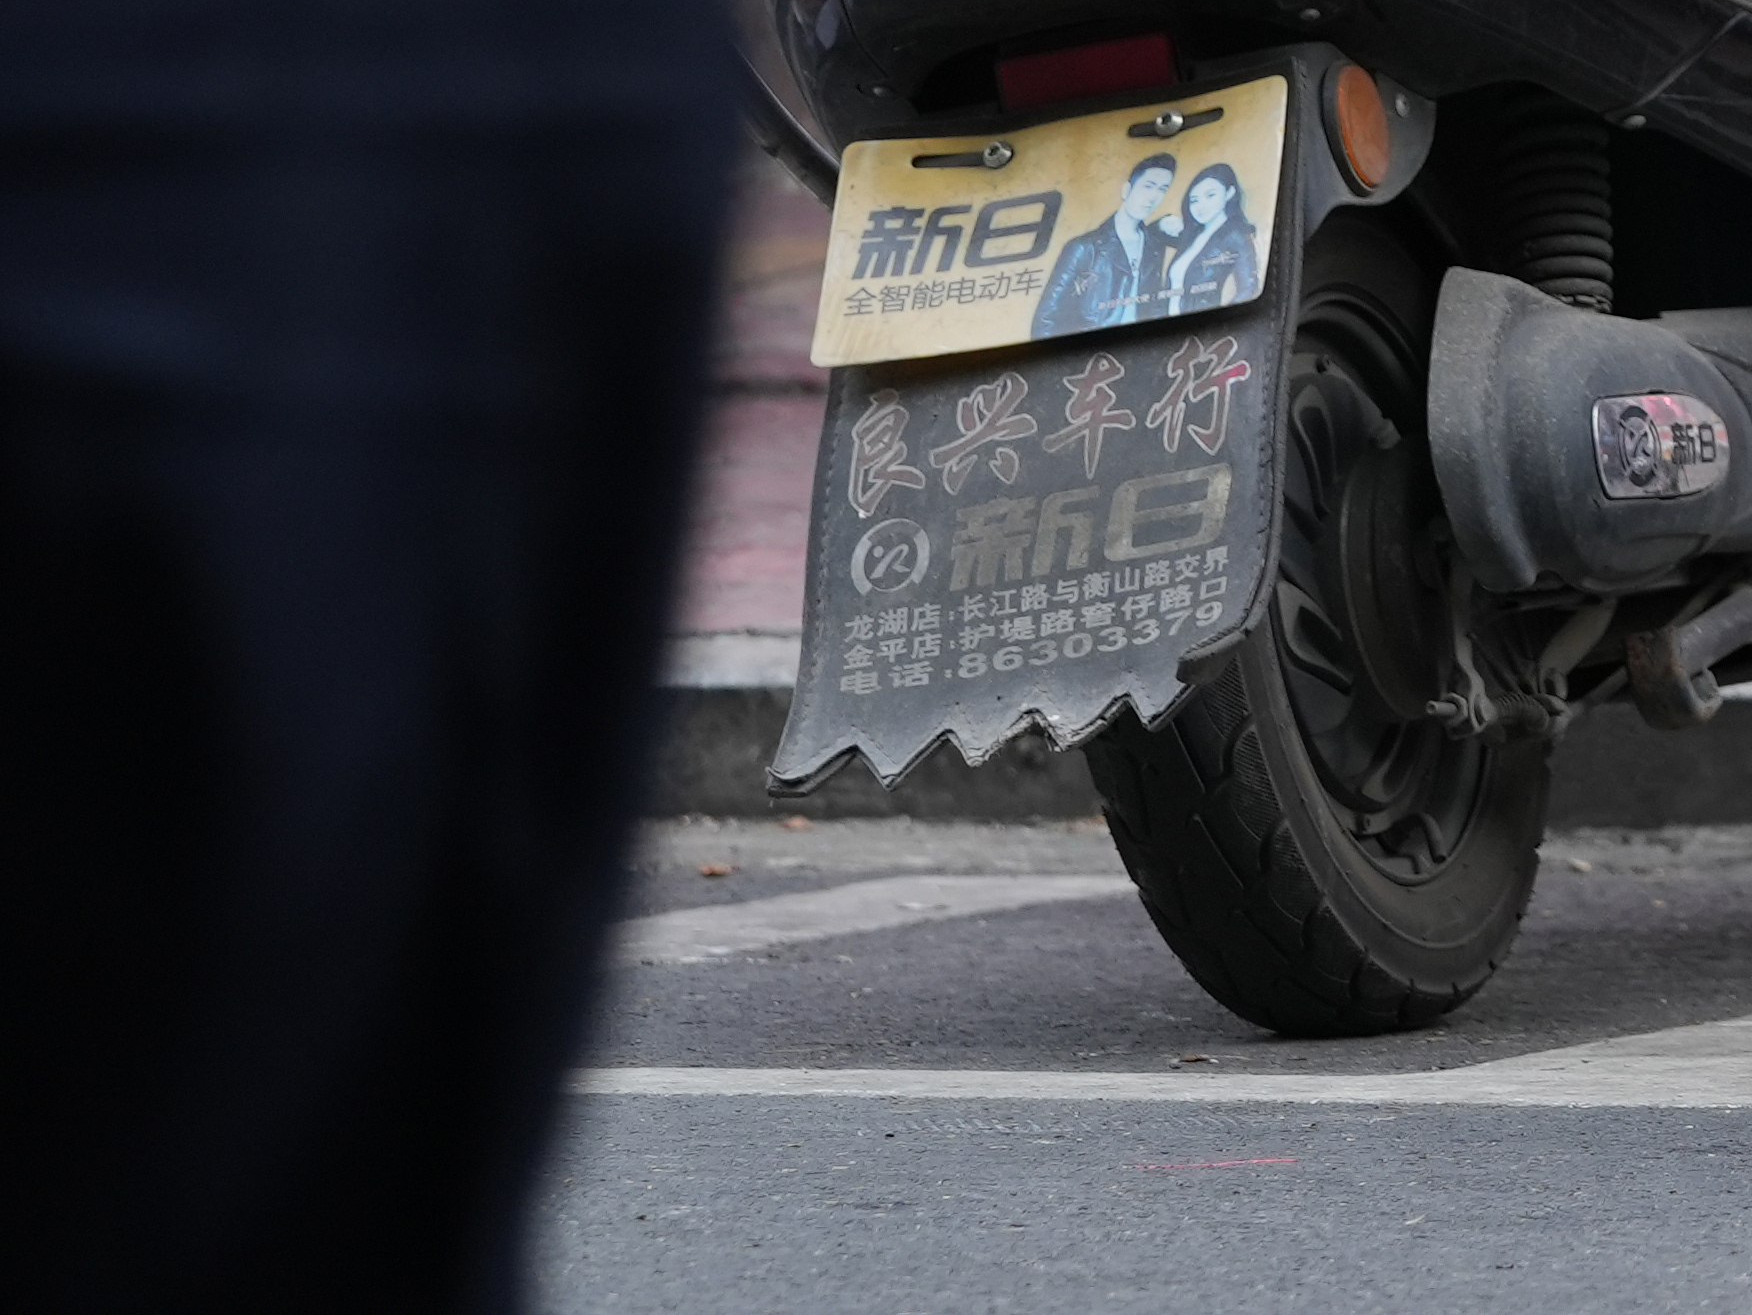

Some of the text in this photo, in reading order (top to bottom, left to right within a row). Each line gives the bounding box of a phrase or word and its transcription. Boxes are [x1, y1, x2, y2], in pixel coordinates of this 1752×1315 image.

[852, 187, 1064, 281] 新日
[842, 267, 1045, 319] 全智能电动车
[848, 334, 1252, 519] 良兴车行
[1670, 421, 1718, 467] 新日
[948, 462, 1233, 593] 新日
